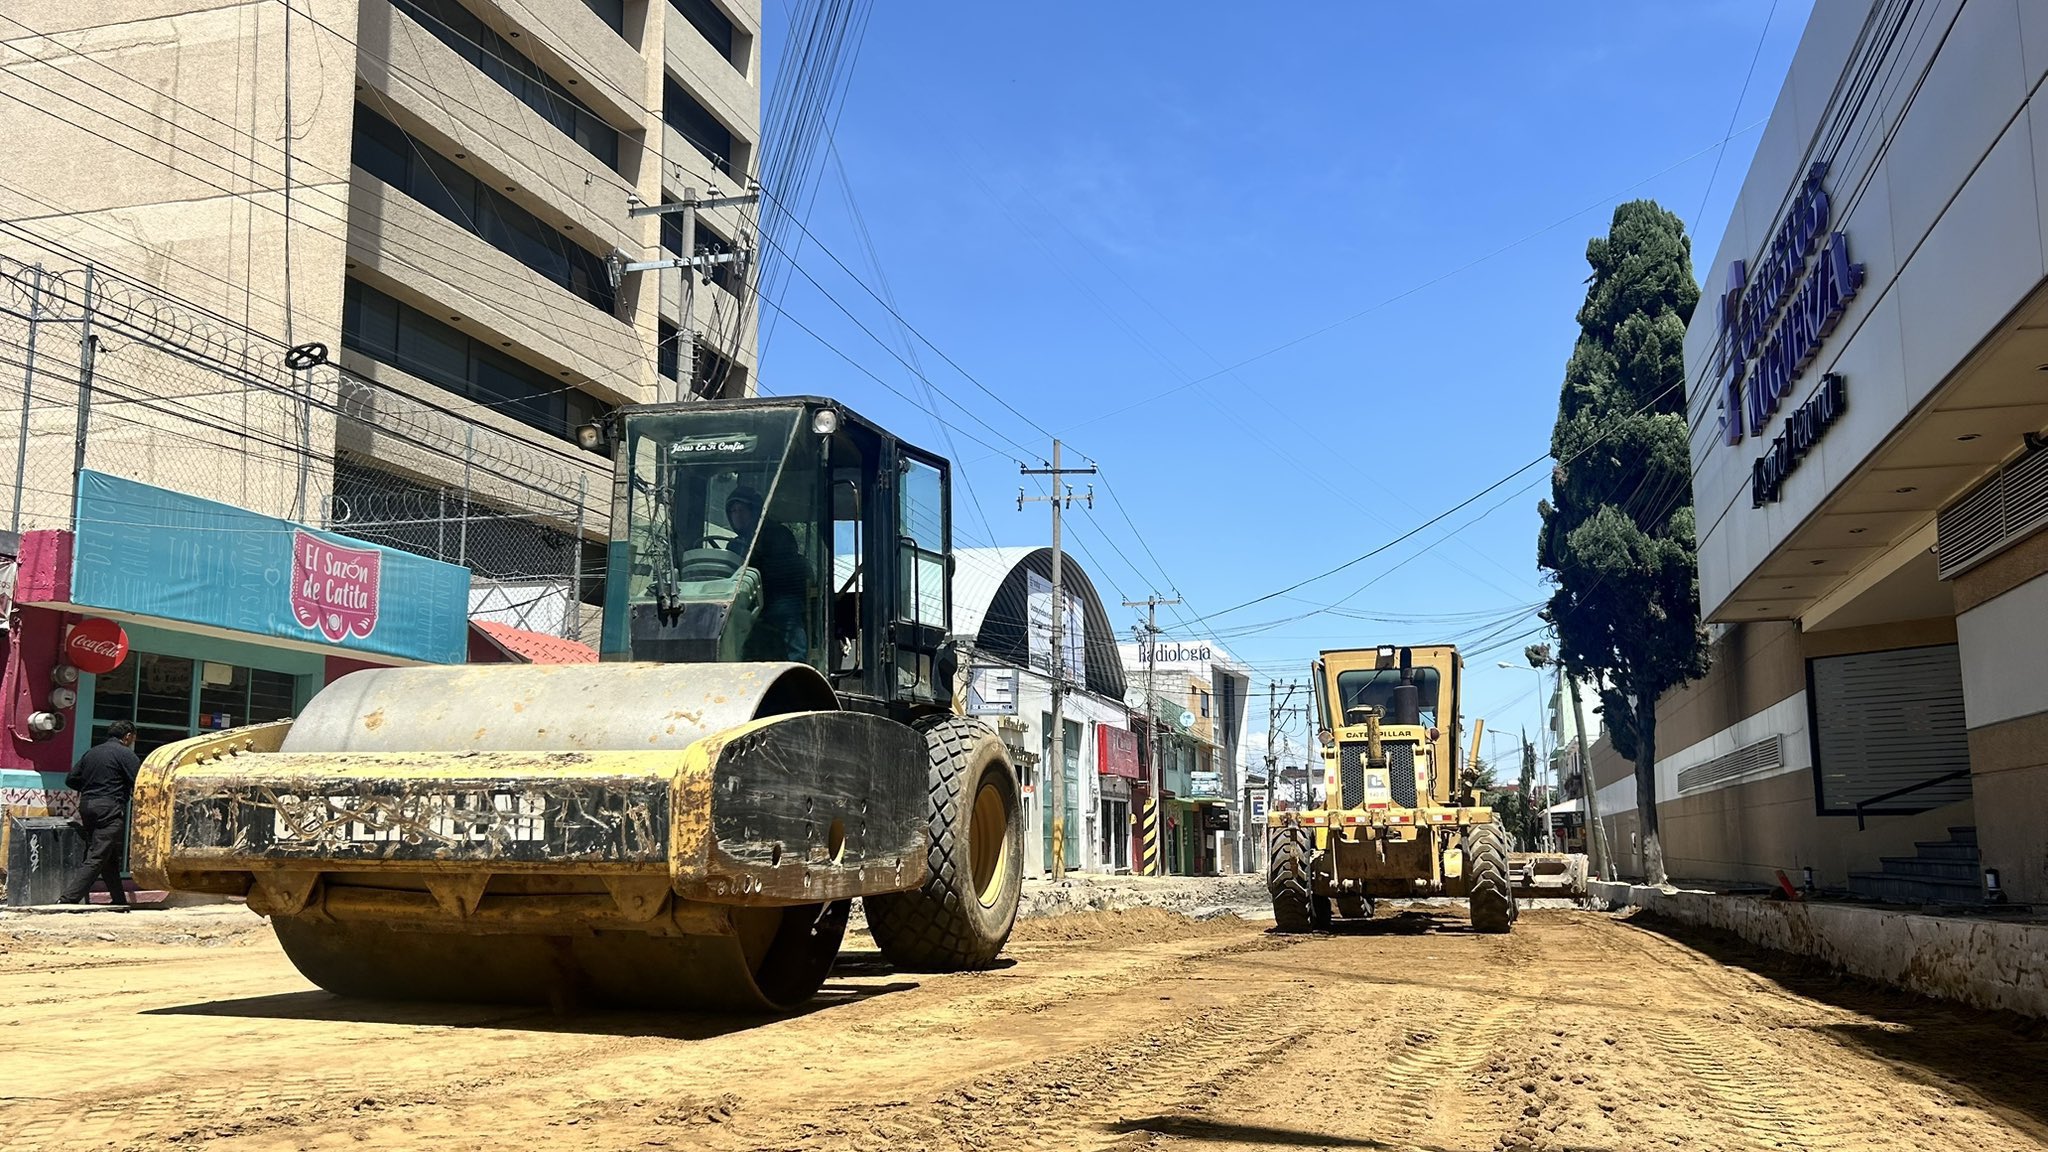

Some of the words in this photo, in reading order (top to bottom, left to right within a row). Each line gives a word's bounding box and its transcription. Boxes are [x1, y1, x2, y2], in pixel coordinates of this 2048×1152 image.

[695, 442, 706, 451] En
[168, 536, 238, 589] TORTAS
[305, 543, 319, 572] El
[78, 568, 171, 614] DESAYUNOS
[302, 578, 320, 601] de
[325, 581, 368, 609] Catita
[1253, 801, 1265, 815] E
